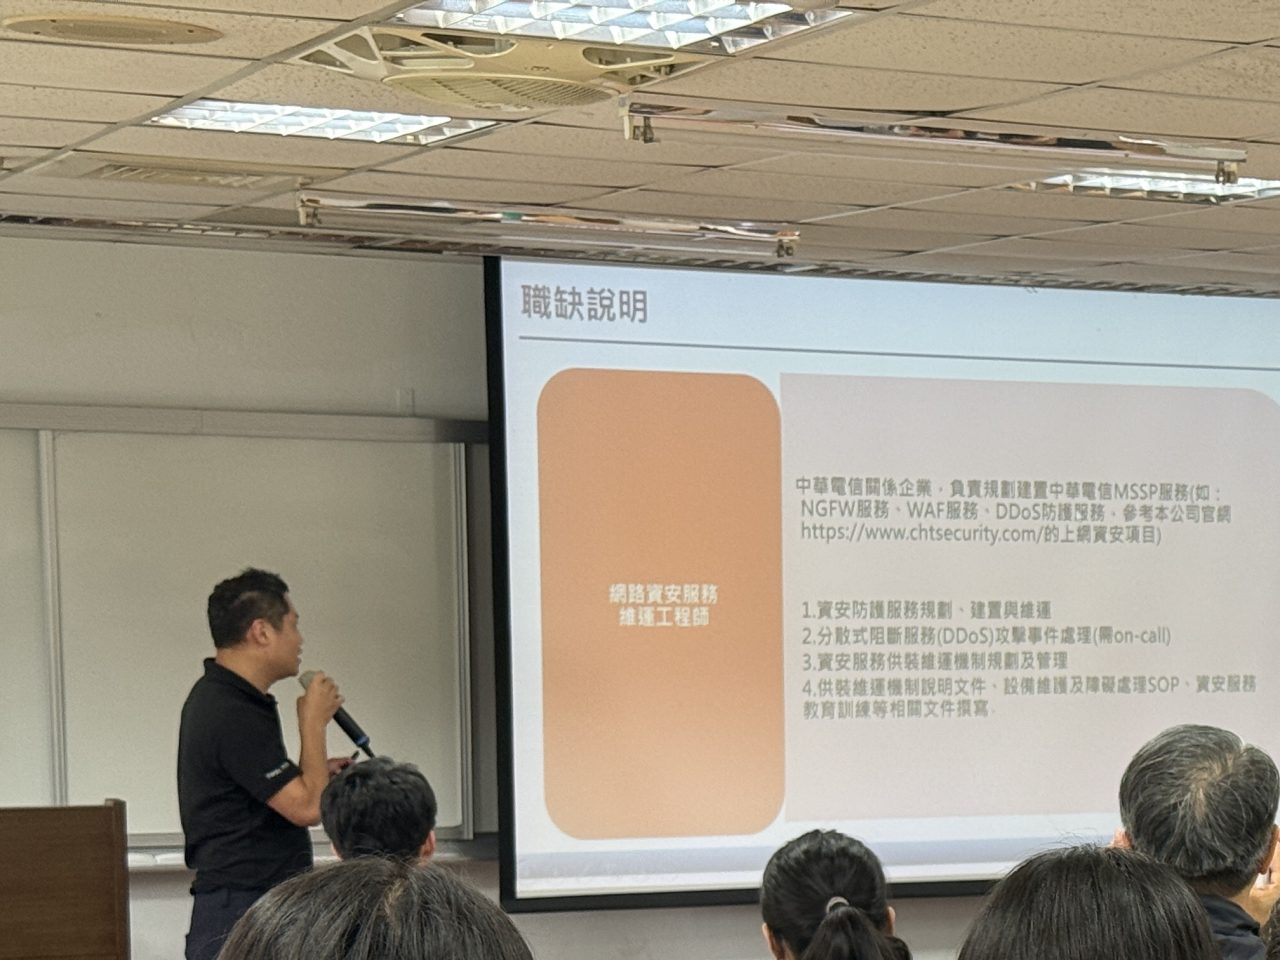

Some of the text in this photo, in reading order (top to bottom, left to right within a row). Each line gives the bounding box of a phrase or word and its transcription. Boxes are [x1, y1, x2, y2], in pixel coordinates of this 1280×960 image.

[521, 284, 648, 323] 職缺說明
[618, 606, 709, 627] 維運工程師
